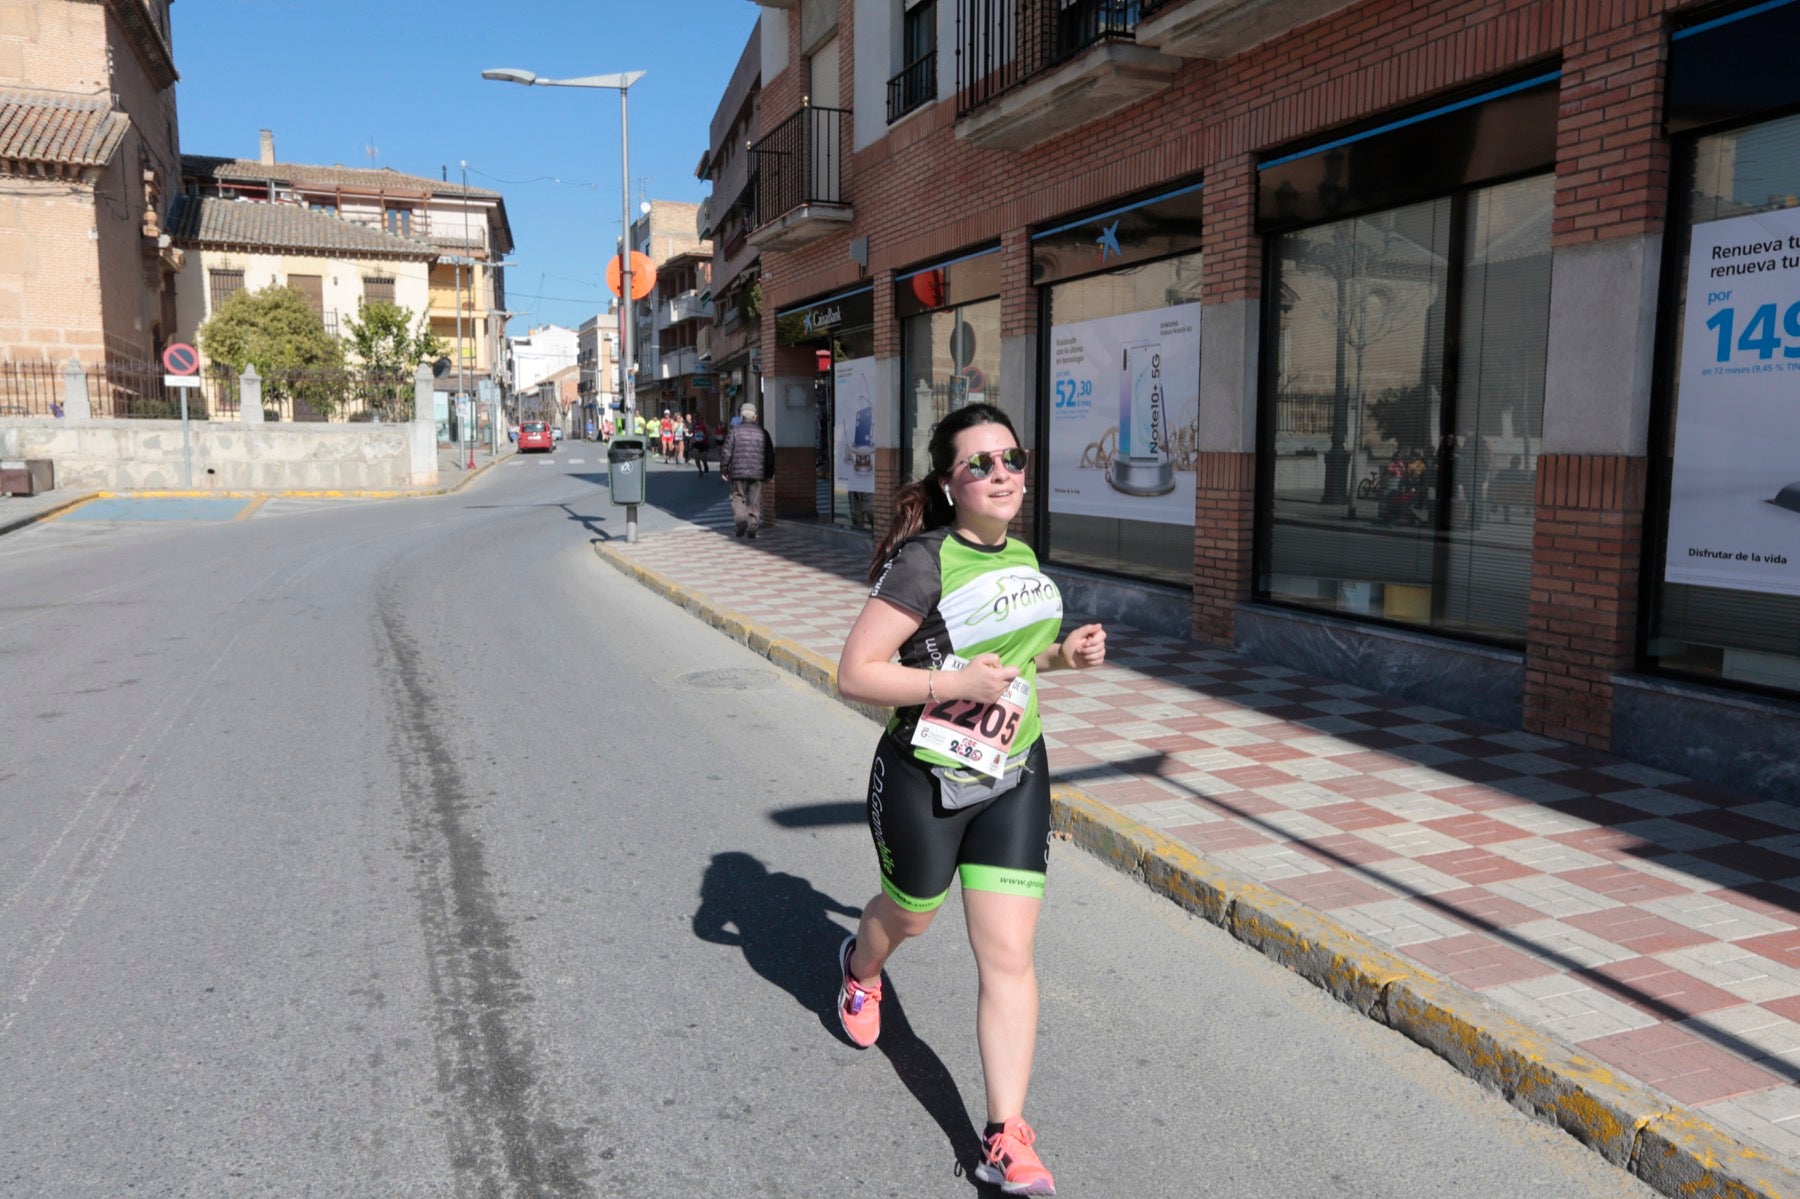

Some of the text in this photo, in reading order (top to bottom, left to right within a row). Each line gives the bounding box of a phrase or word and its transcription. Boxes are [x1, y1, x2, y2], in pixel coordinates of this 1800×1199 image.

[1711, 234, 1800, 260] Renueva tu
[1710, 255, 1800, 278] renueva tu
[1707, 289, 1732, 305] por
[1725, 366, 1750, 375] meses
[1055, 379, 1092, 408] 52,30
[1149, 353, 1160, 454] Note10+ 5G
[1688, 547, 1787, 564] Disfrutar de la vida
[929, 698, 1020, 746] 2205
